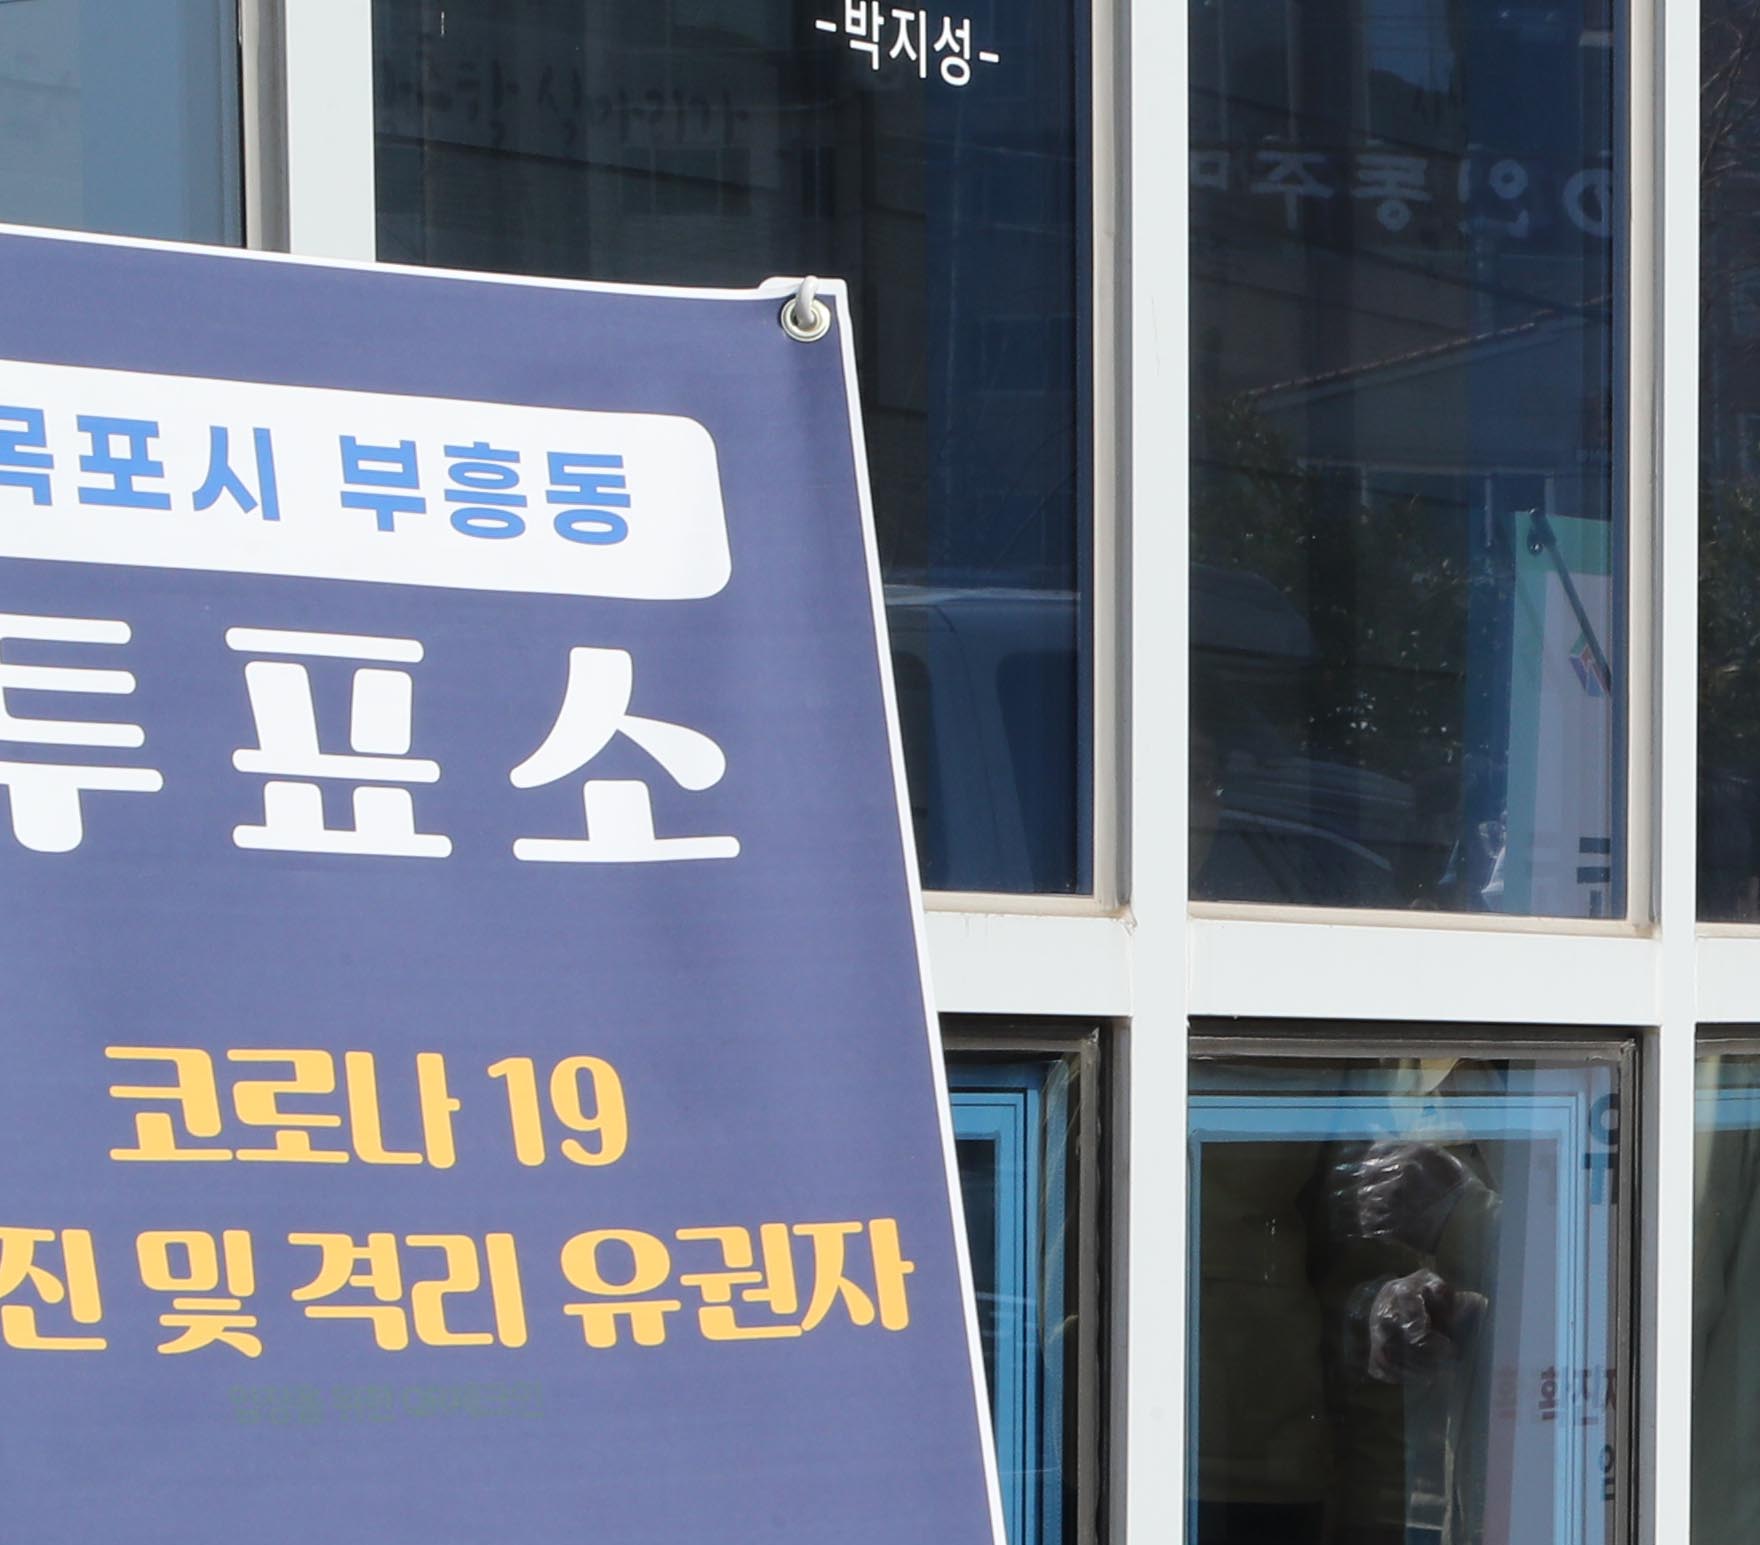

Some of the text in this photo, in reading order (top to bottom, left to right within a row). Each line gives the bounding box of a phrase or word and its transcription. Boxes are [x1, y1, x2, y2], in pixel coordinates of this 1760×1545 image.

[815, 0, 1000, 87] -박지성-
[338, 433, 633, 546] 부흥동
[0, 612, 741, 863] 투표소
[104, 1044, 628, 1169] 코로나 19
[136, 1228, 262, 1358] 및
[288, 1231, 528, 1351] 격리
[560, 1218, 914, 1348] 유권자
